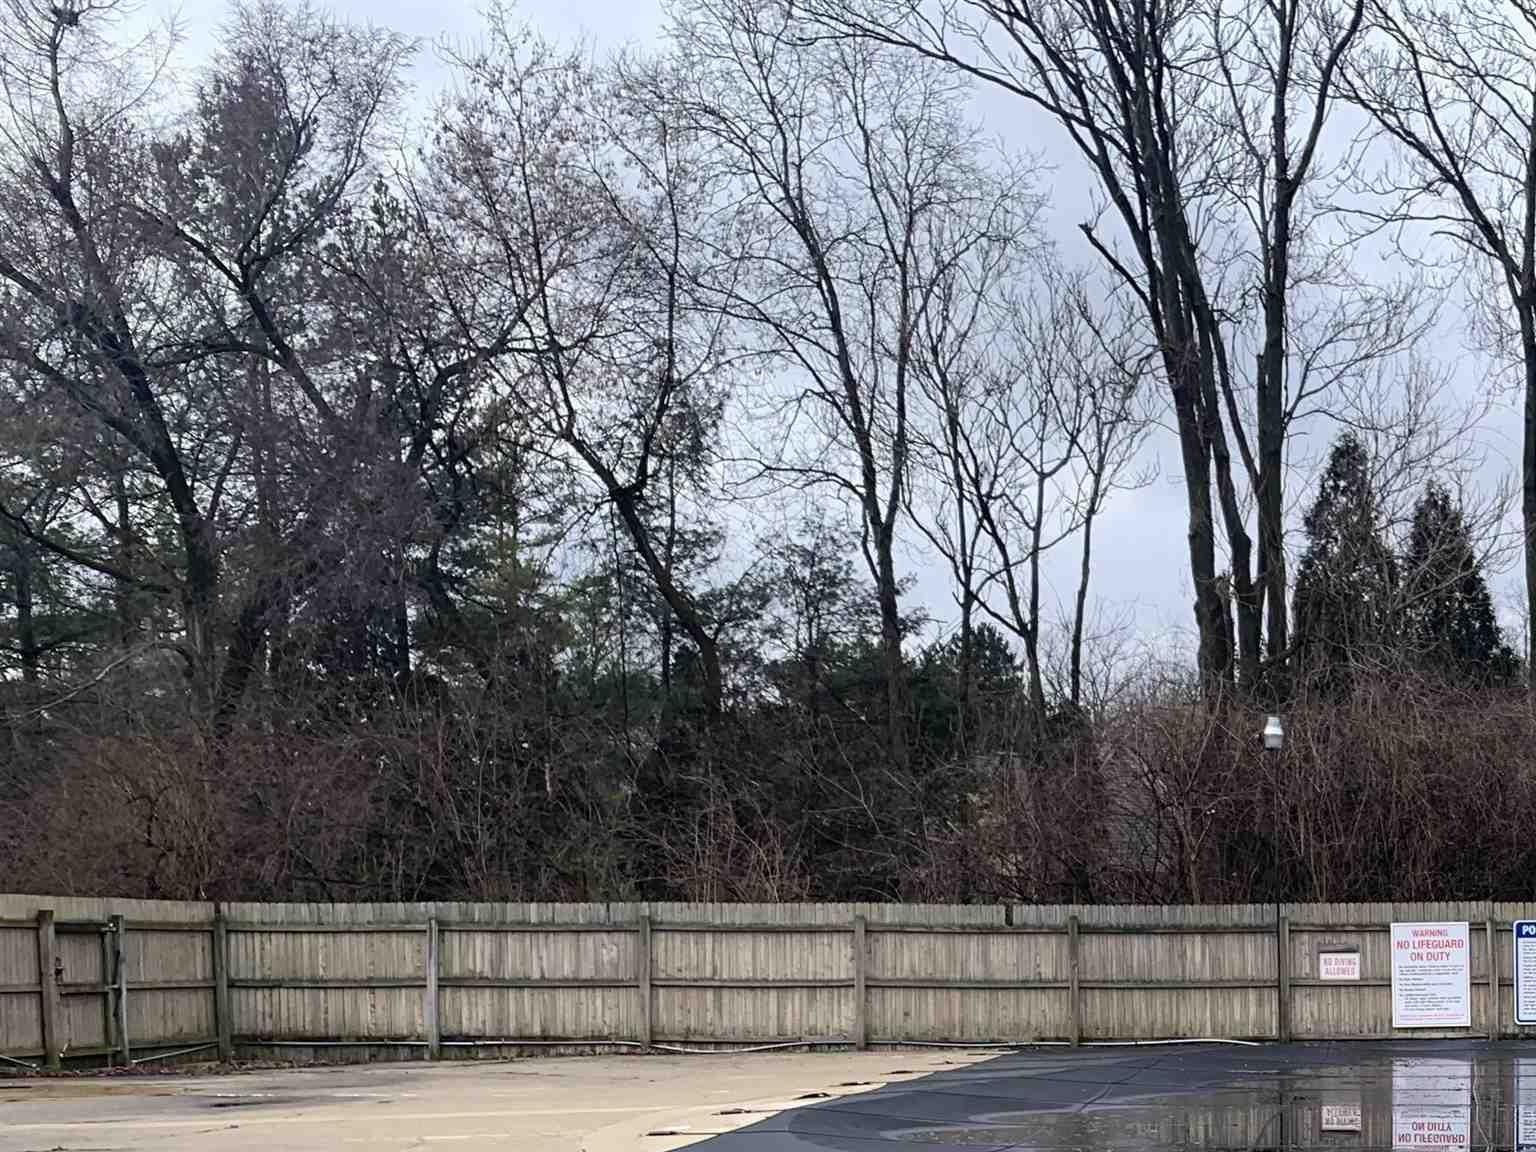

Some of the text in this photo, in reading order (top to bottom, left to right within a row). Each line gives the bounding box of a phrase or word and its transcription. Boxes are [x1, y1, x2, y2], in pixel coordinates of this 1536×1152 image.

[1396, 939, 1464, 950] NO LIFEGUARD
[1410, 952, 1451, 961] ON DUTY
